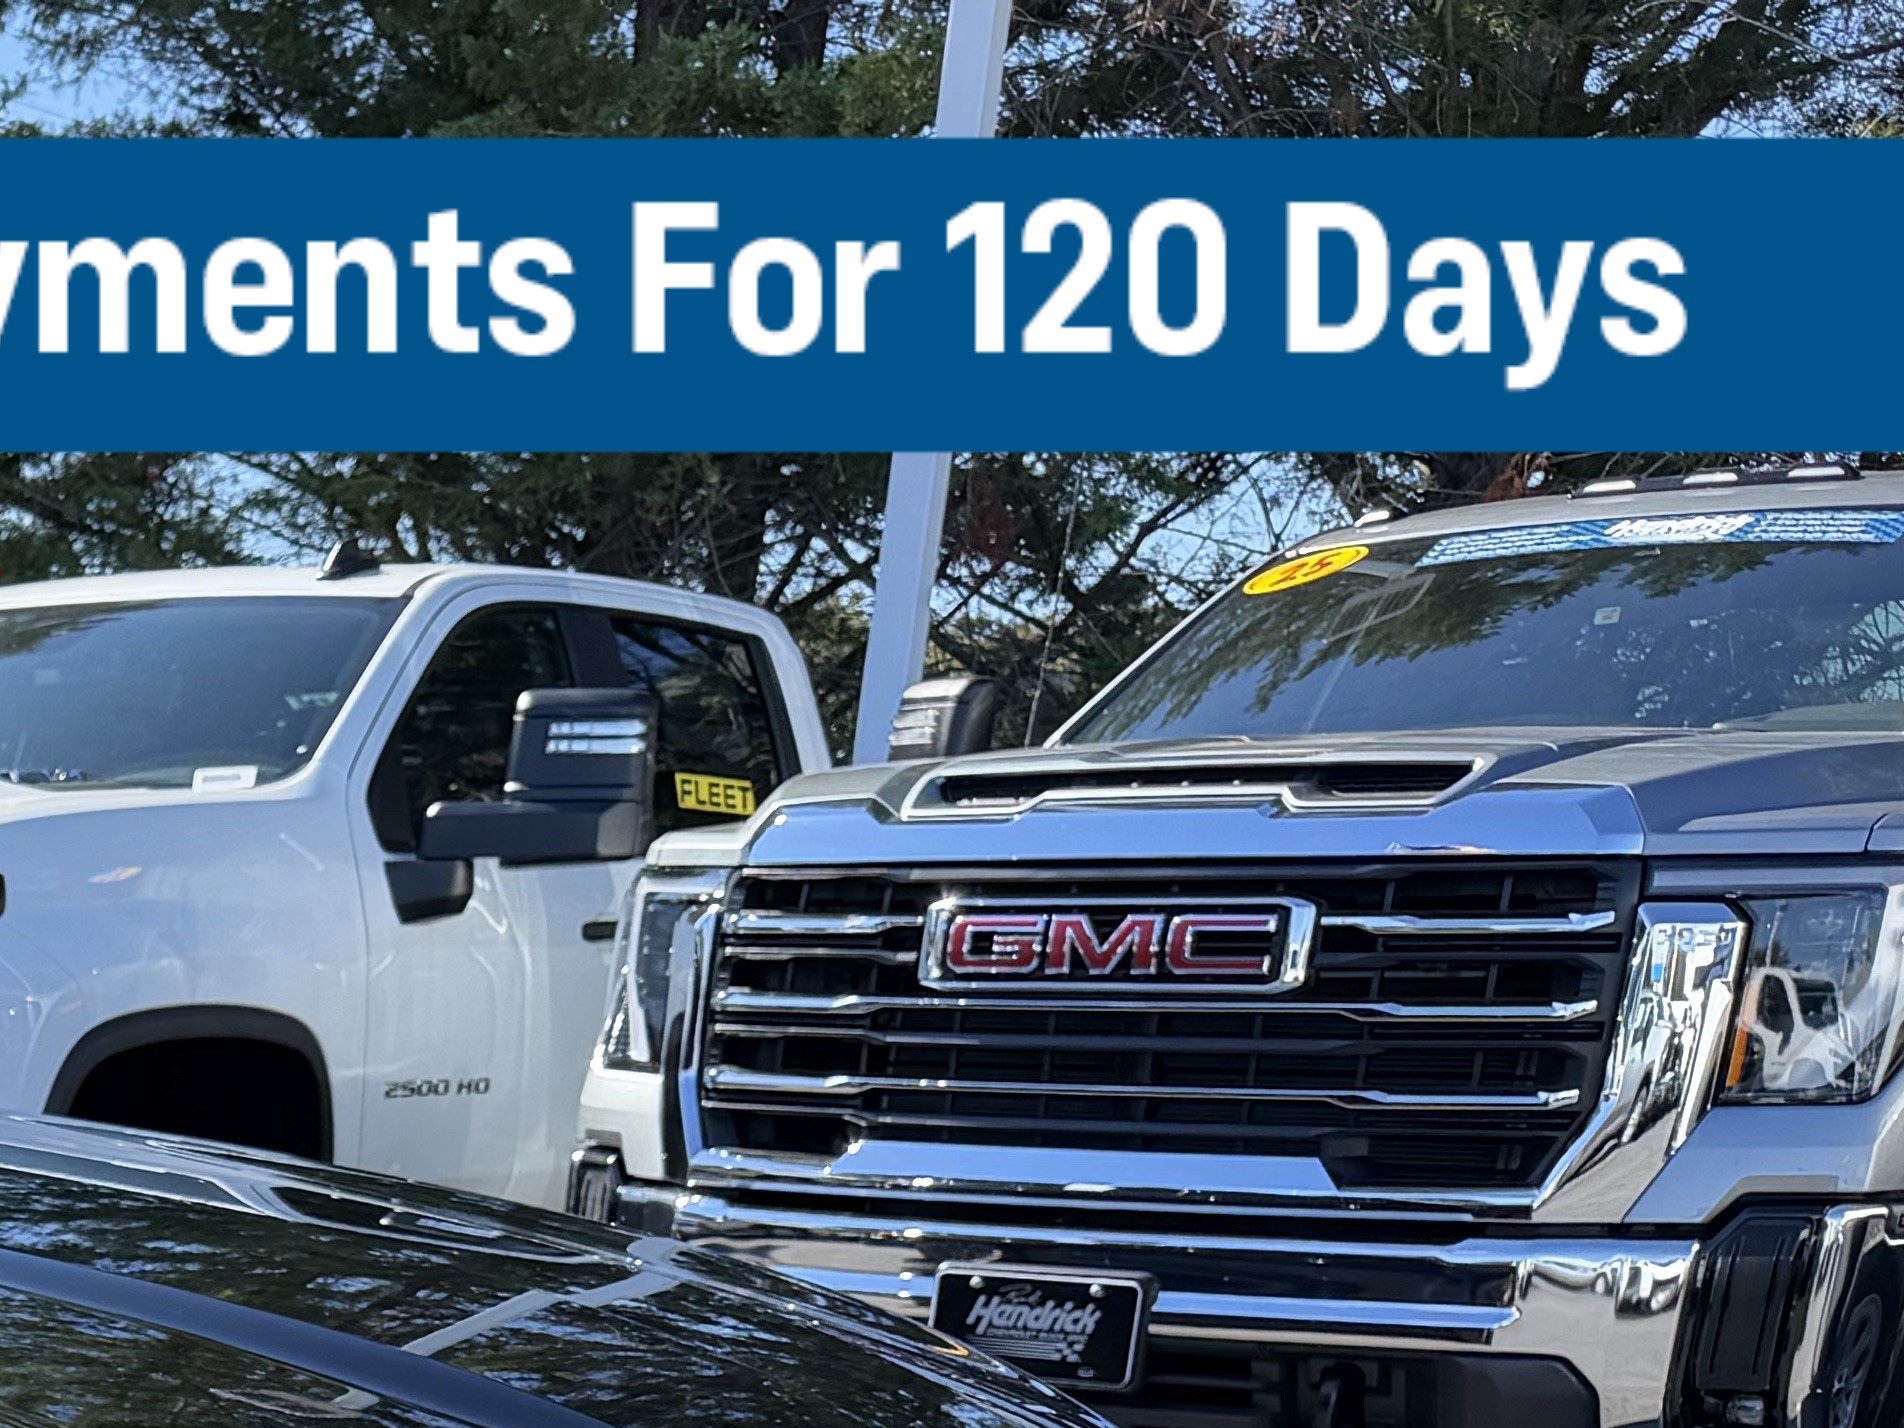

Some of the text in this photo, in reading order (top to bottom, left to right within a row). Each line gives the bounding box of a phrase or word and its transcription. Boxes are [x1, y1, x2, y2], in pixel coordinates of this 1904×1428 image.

[680, 779, 752, 812] FLEET
[946, 913, 1280, 975] GMC
[384, 1079, 450, 1099] 2500
[966, 1294, 1103, 1336] Hendrick
